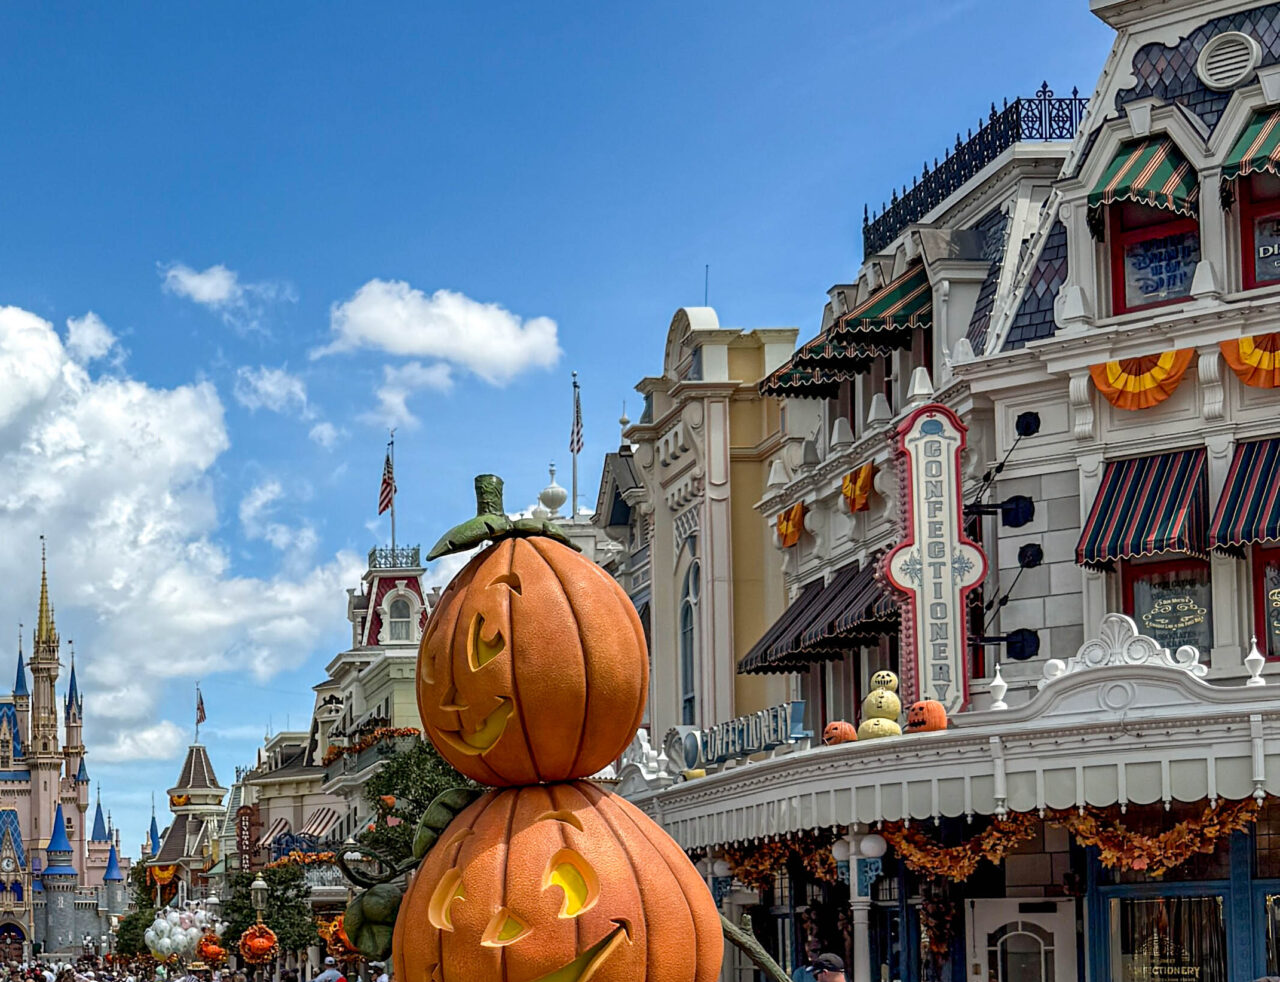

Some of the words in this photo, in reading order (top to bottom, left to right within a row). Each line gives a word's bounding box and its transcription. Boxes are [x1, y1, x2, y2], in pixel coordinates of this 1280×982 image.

[1259, 244, 1280, 258] DI
[923, 439, 952, 706] CONFECTIONERY
[1127, 965, 1200, 979] NFECTIONERY
